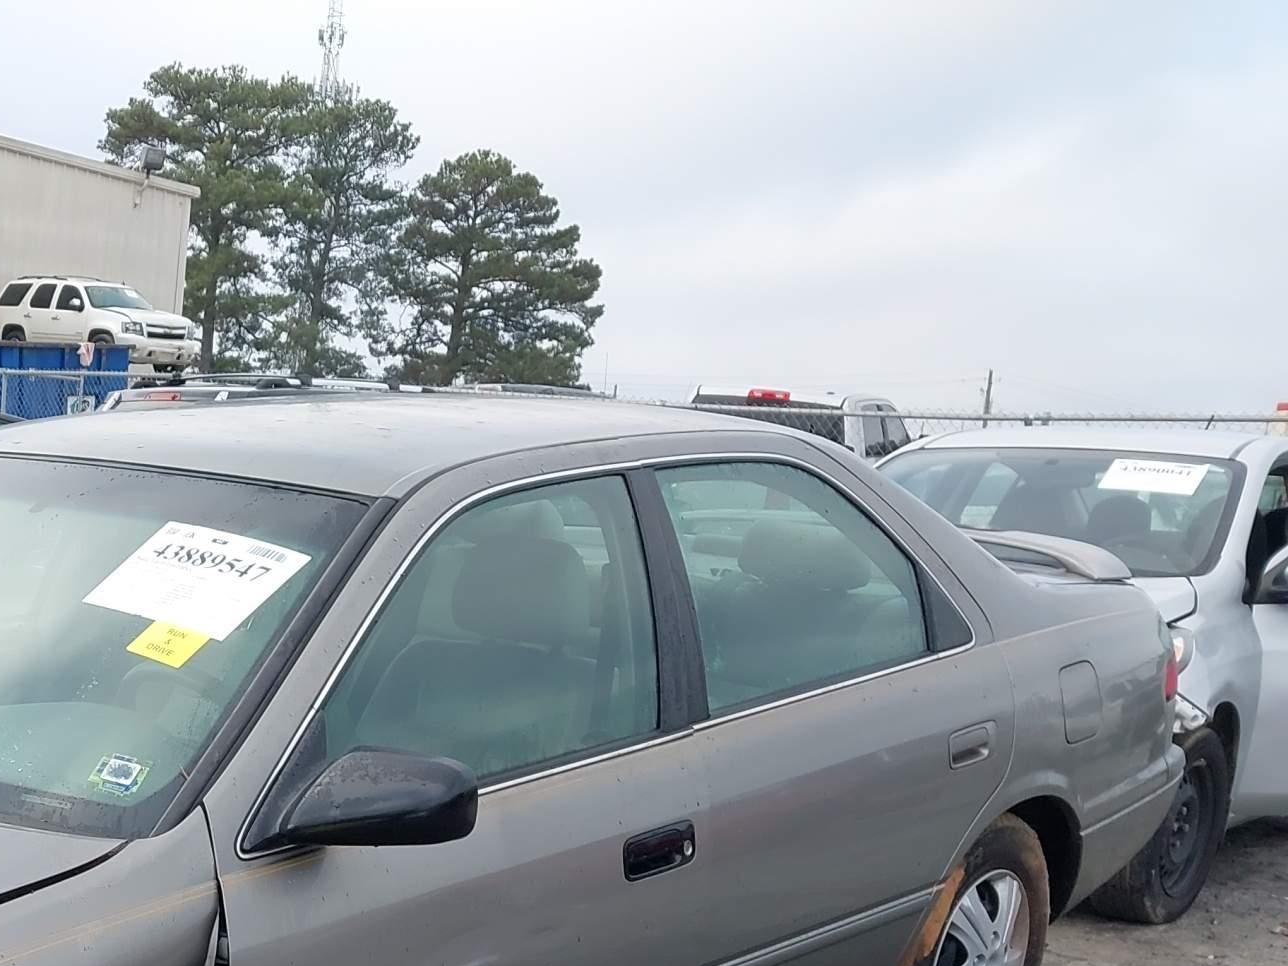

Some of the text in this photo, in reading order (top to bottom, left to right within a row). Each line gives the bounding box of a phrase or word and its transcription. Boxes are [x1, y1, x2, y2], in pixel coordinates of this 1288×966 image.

[153, 543, 273, 582] 43889547
[166, 628, 188, 639] RUN
[145, 642, 175, 657] DRIVE
